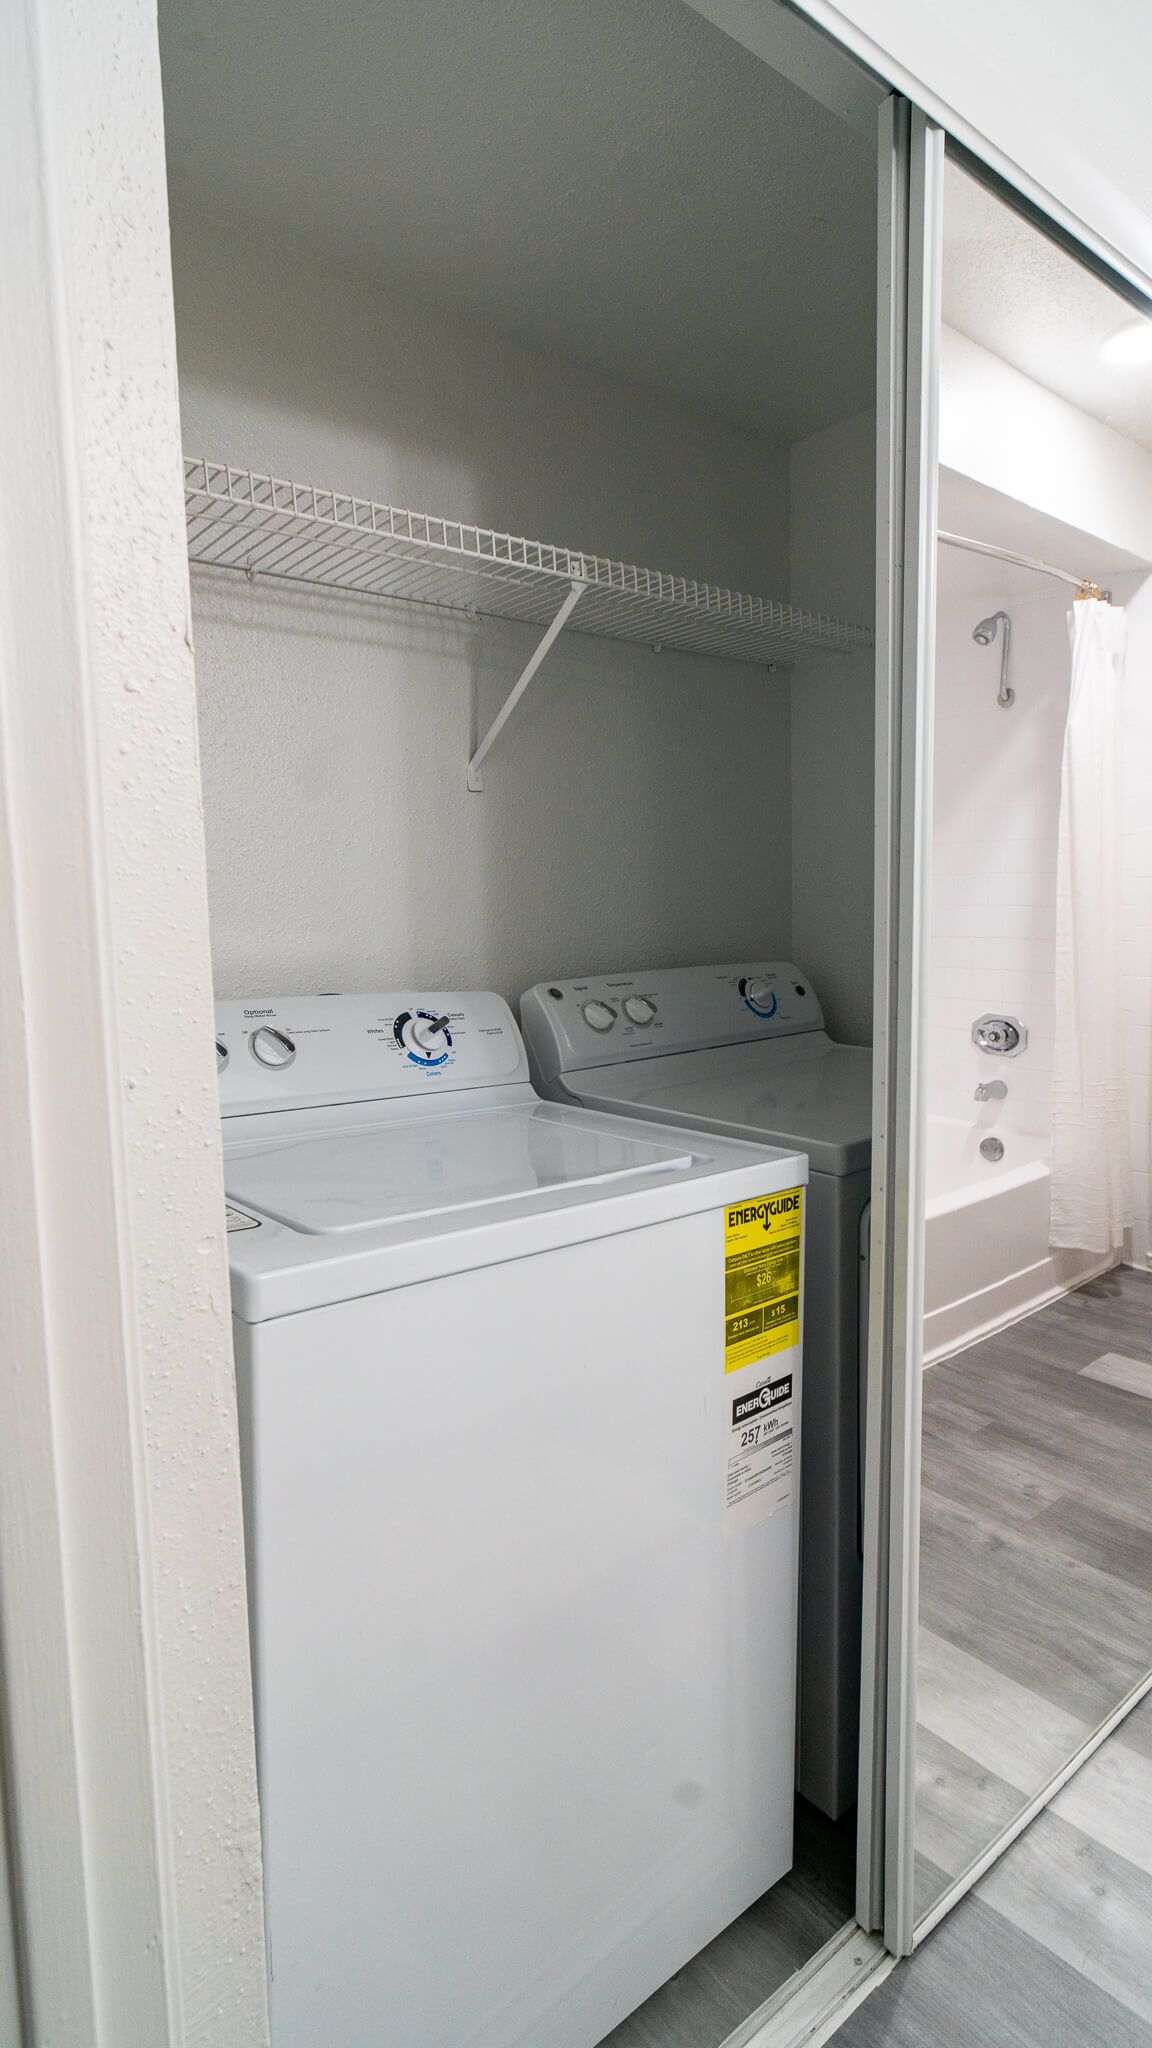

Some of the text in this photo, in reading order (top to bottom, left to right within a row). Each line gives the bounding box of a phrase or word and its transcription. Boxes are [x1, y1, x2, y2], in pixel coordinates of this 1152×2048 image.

[243, 1008, 274, 1016] Optional
[728, 1194, 800, 1231] ENERGYGUIDE
[756, 1271, 772, 1287] $26
[732, 1318, 749, 1332] 213
[735, 1382, 790, 1417] ENERGUIDE
[741, 1424, 762, 1447] 257
[763, 1418, 779, 1432] kWh
